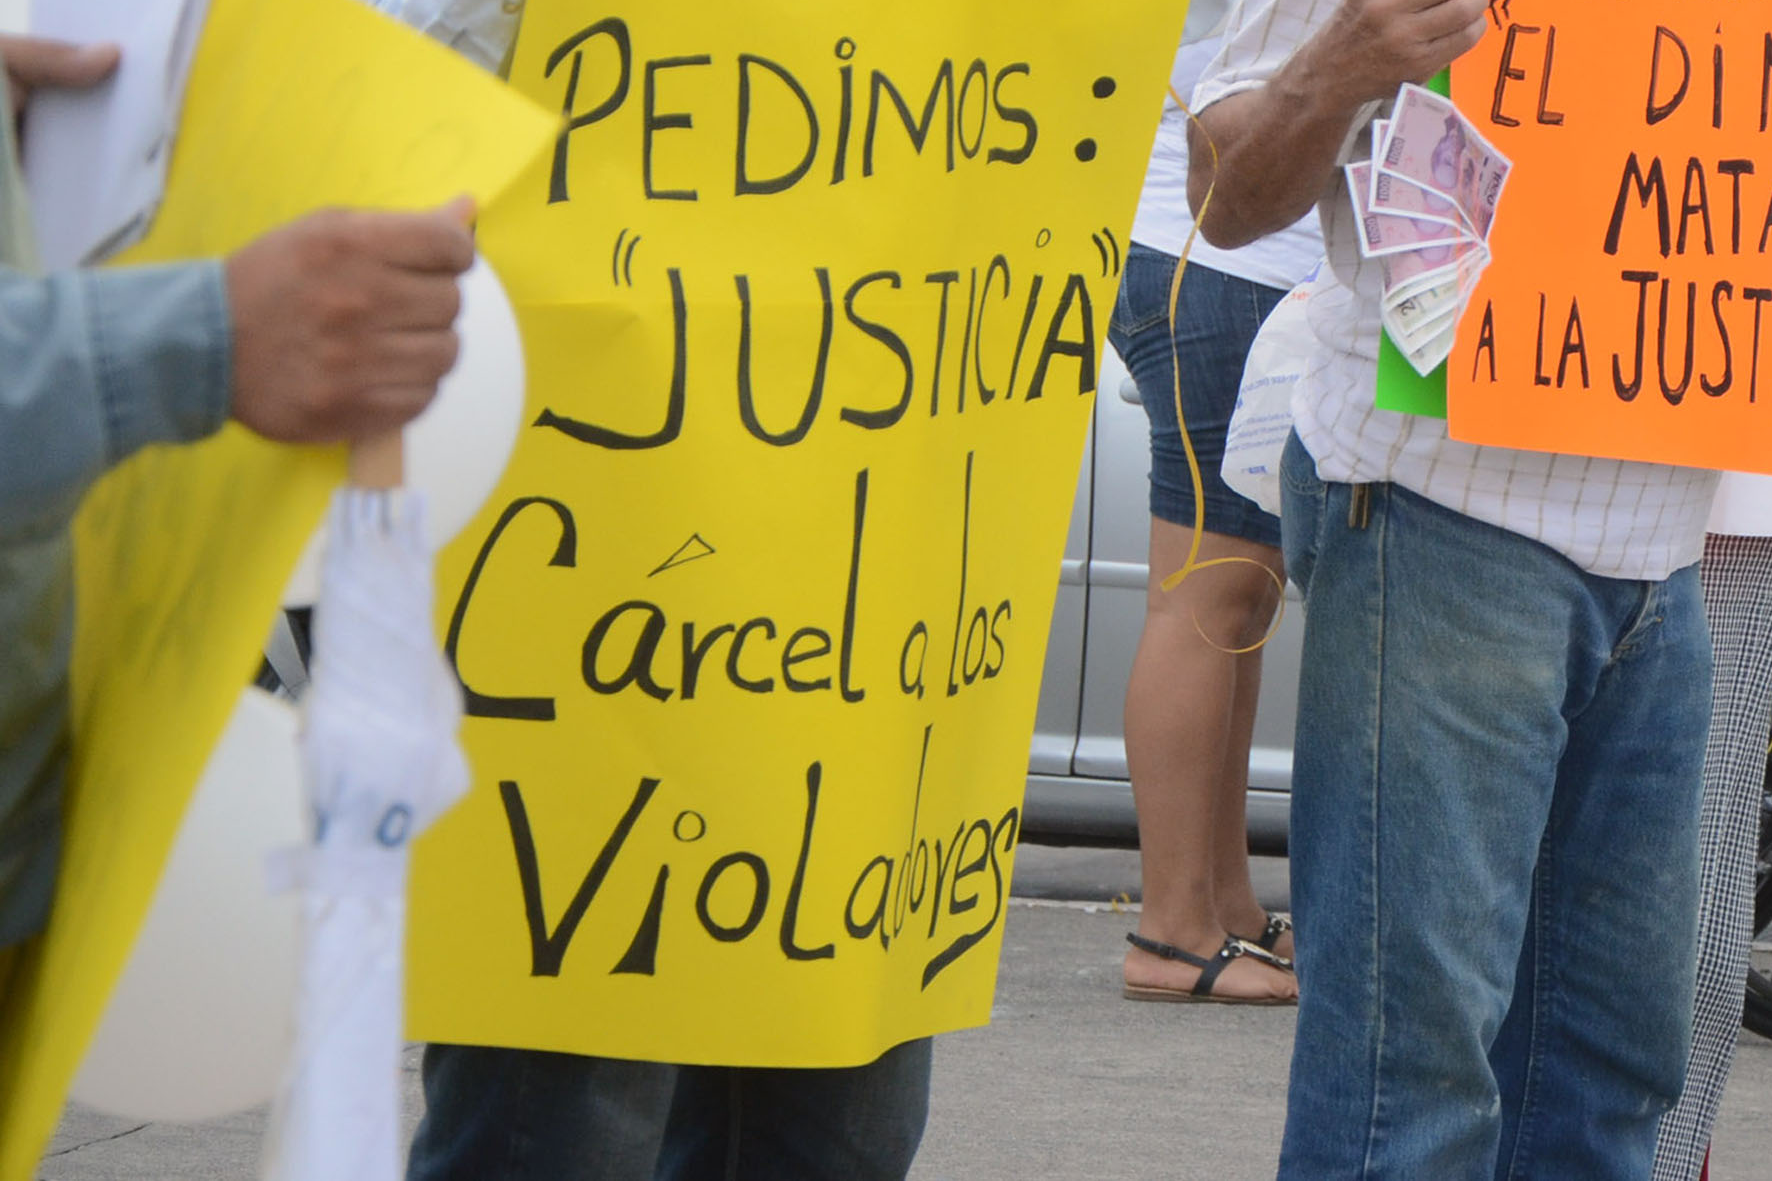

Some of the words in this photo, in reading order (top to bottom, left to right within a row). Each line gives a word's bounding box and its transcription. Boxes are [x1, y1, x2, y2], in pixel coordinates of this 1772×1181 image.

[1471, 298, 1498, 383] A
[1533, 291, 1591, 389] LA
[442, 467, 865, 721] Cárcel
[898, 619, 929, 699] a
[946, 451, 1013, 698] los
